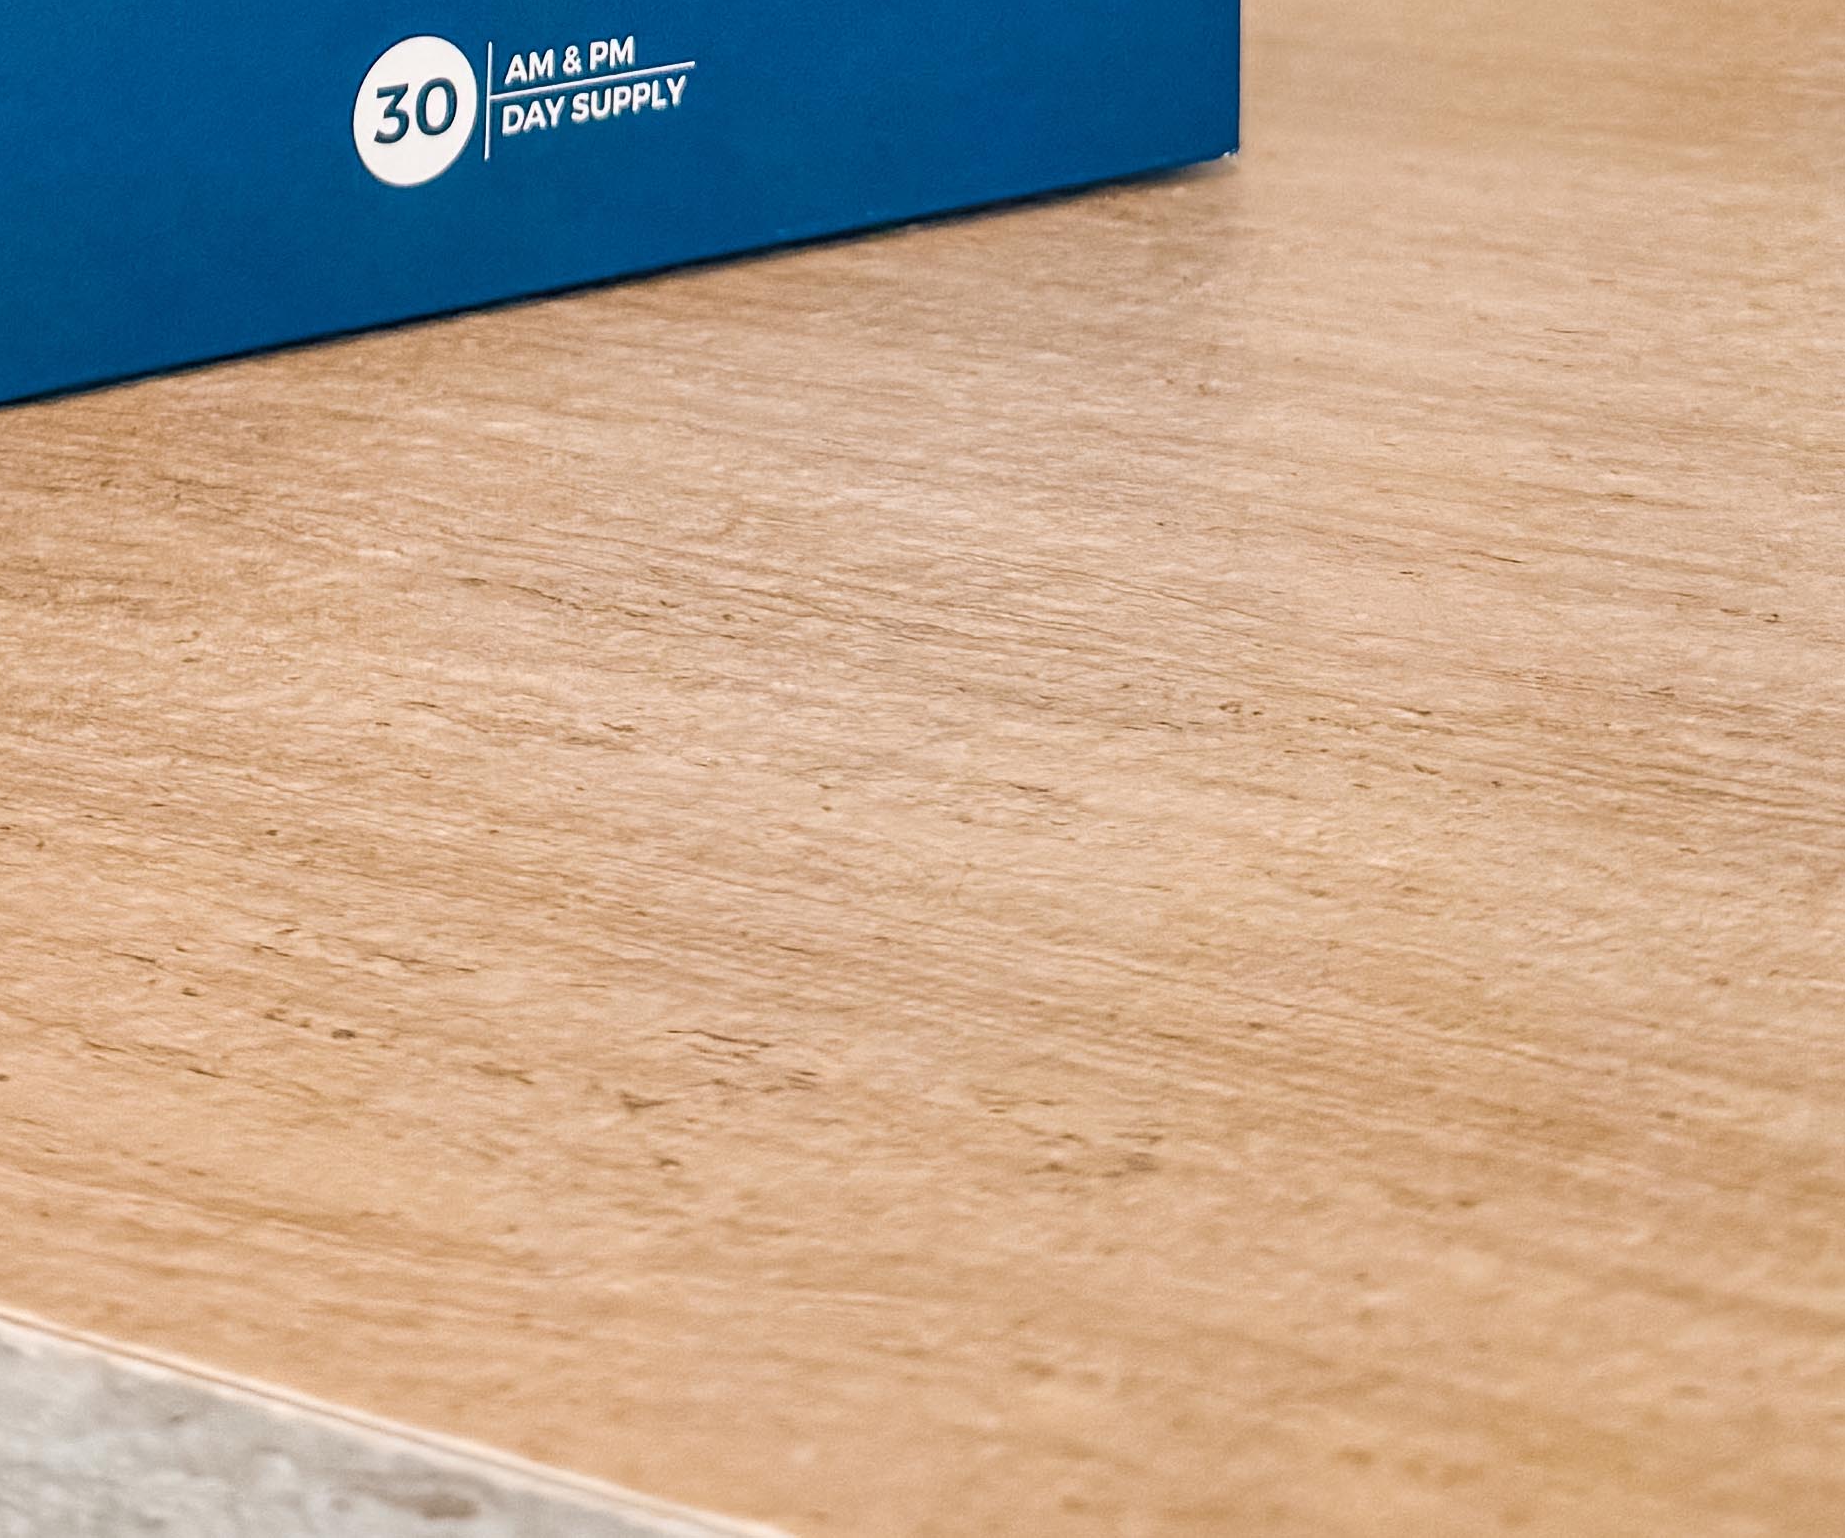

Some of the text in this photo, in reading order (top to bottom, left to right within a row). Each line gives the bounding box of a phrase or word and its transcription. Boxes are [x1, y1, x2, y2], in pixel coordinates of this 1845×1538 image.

[506, 35, 635, 86] AM & PM
[374, 77, 457, 144] 30
[502, 75, 687, 136] DAY SUPPLY
